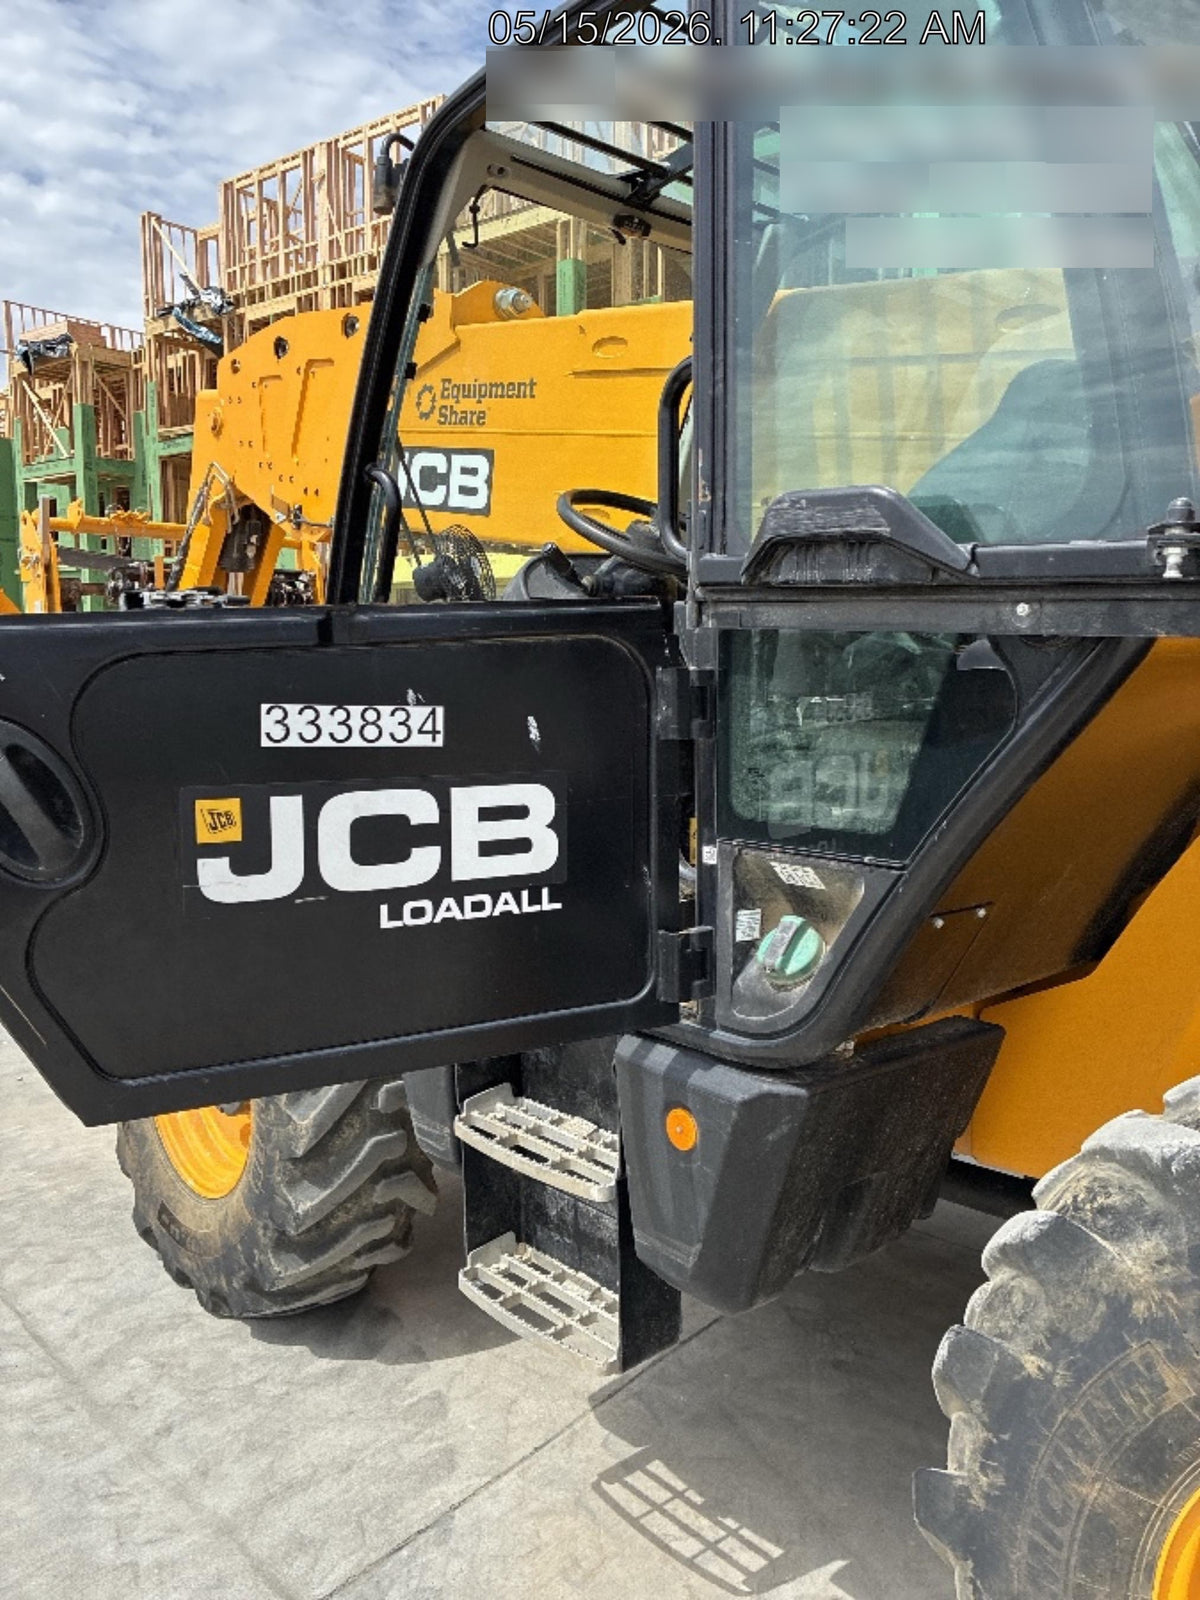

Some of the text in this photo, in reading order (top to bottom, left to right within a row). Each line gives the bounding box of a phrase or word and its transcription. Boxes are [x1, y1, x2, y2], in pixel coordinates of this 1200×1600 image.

[441, 379, 537, 404] Equipment
[438, 406, 487, 426] Share
[264, 705, 442, 744] 333834
[207, 809, 234, 831] JCB
[196, 783, 560, 905] JCB
[379, 886, 563, 929] LOADALL
